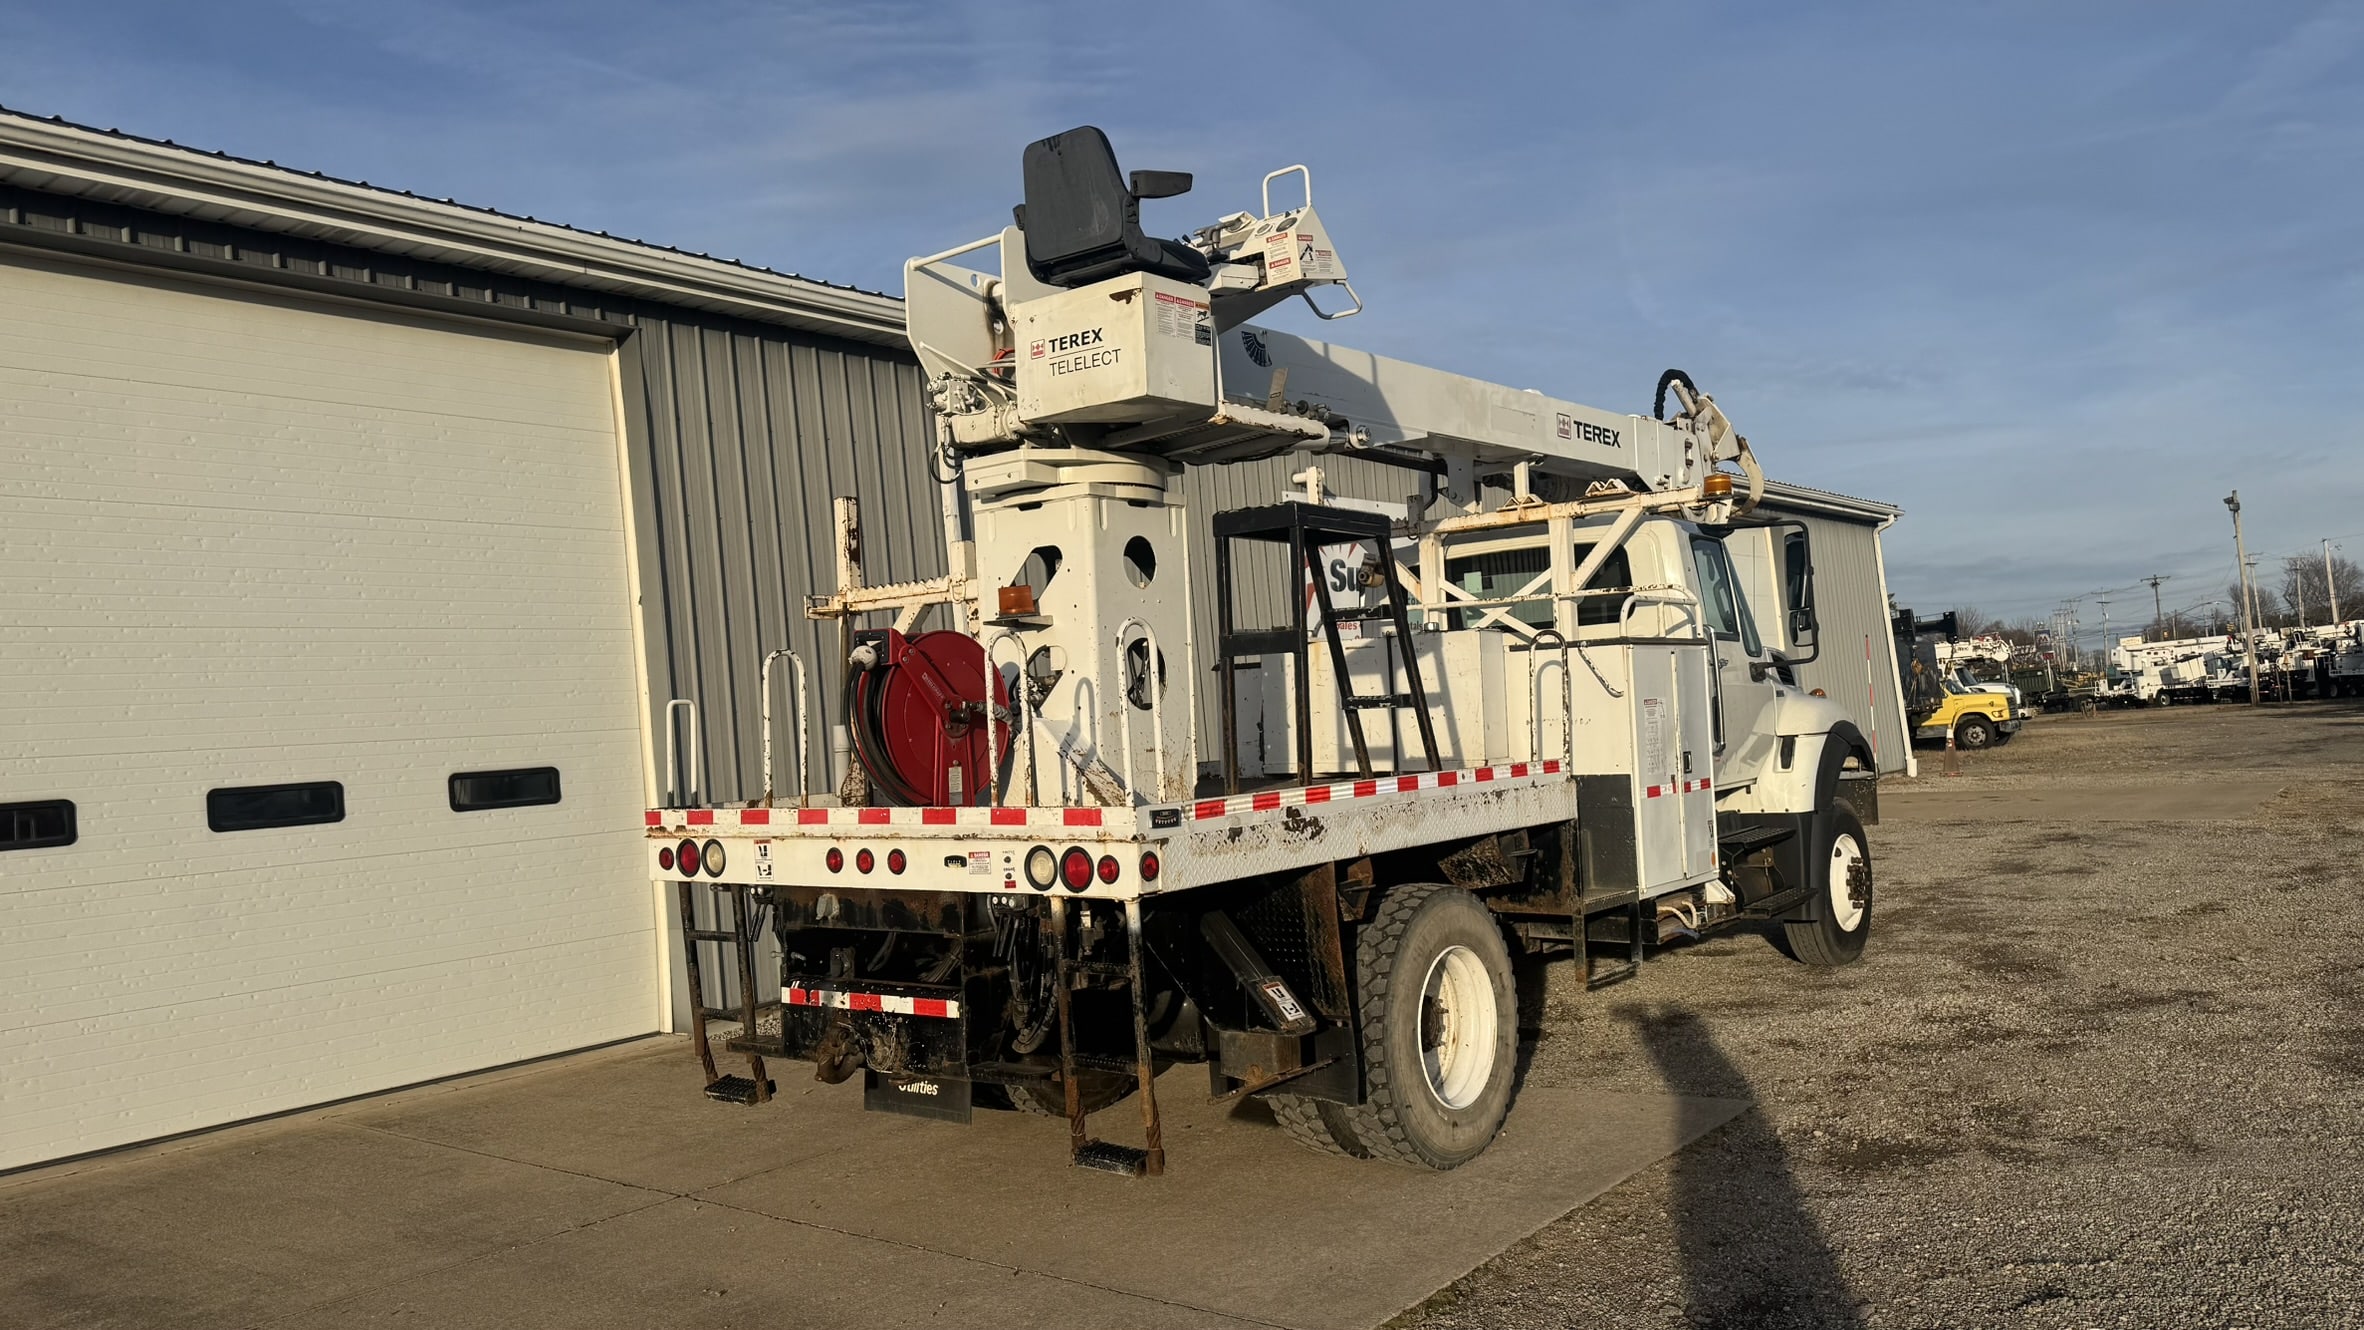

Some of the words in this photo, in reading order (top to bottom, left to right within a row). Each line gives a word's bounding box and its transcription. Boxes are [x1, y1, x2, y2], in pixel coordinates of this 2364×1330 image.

[1048, 327, 1103, 353] TEREX
[1049, 348, 1122, 377] TELELECT
[1573, 420, 1621, 448] TEREX
